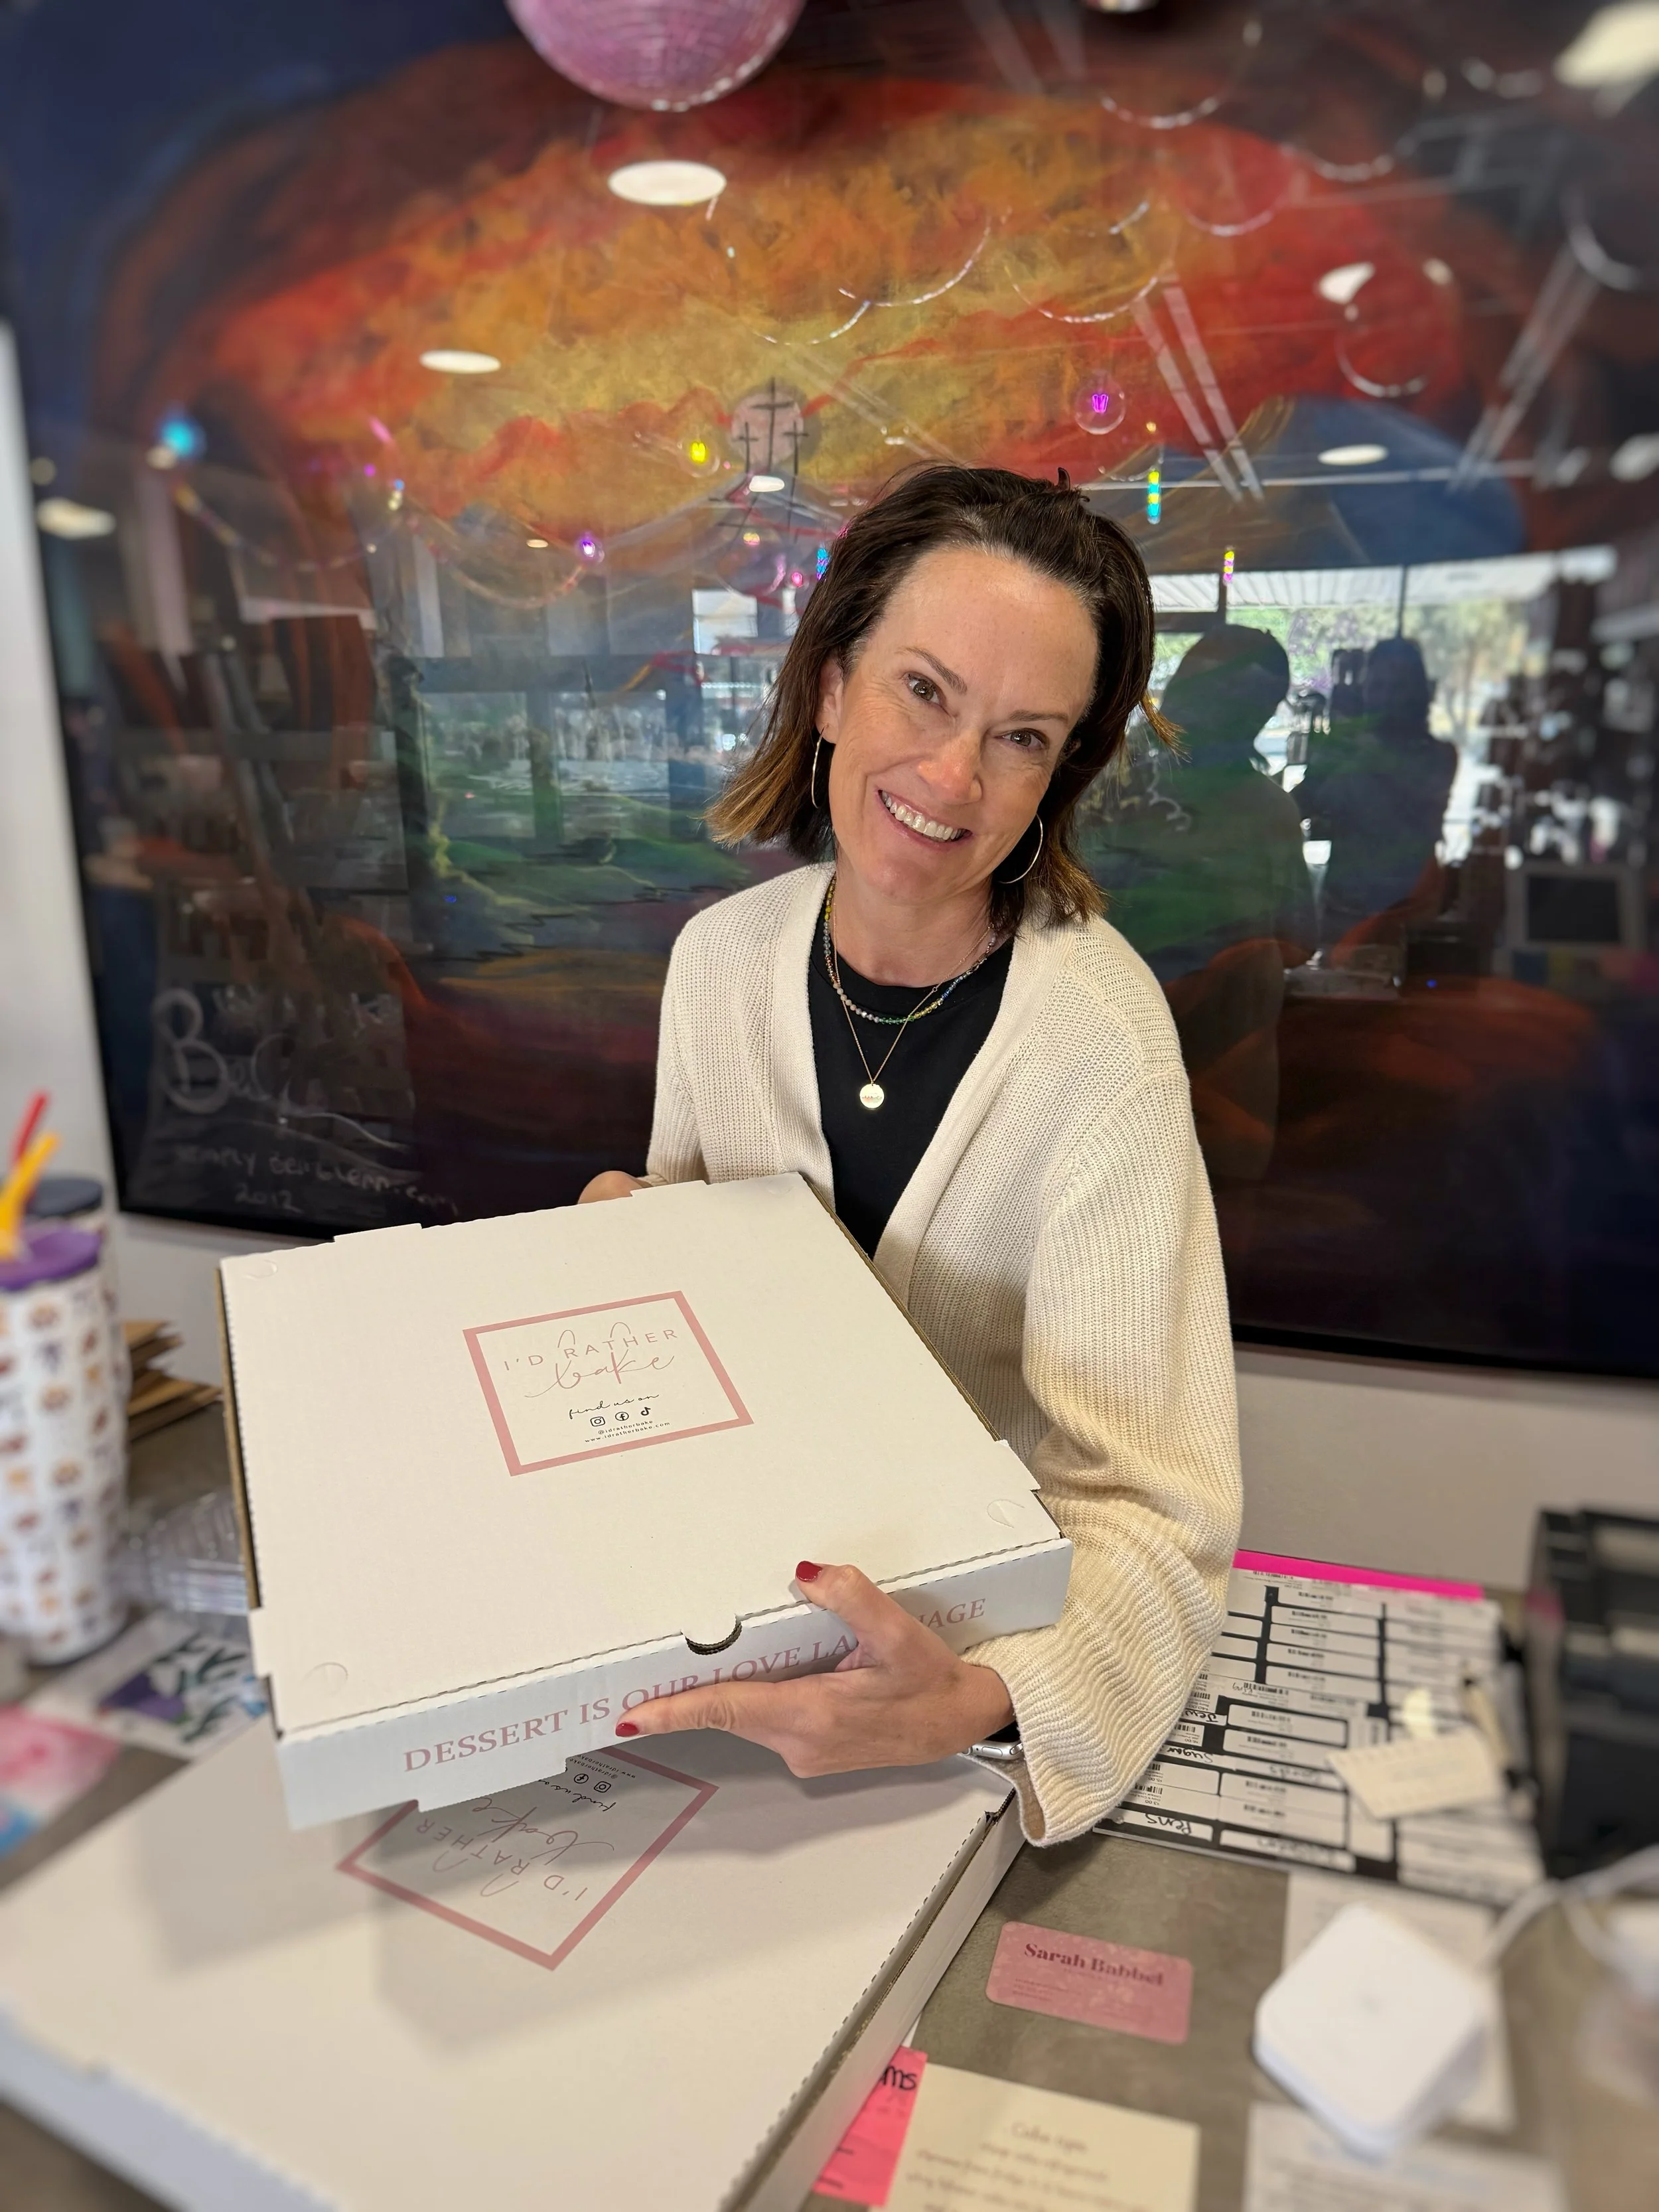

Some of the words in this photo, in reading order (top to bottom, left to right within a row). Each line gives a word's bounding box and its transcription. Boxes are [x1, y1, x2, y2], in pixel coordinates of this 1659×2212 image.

[504, 1354, 543, 1371] I'D
[563, 1329, 678, 1359] RATHER
[524, 1321, 675, 1398] bake
[569, 1400, 611, 1420] find
[585, 1422, 670, 1443] www.idratherbake.com
[598, 1420, 654, 1435] @idratherbake
[403, 1709, 568, 1772] DESSERT
[579, 1697, 611, 1725] IS
[621, 1674, 699, 1710] OUR
[712, 1647, 800, 1685] LOVE
[812, 1597, 987, 1661] LAAGE
[1166, 1747, 1214, 1763] Sugar
[569, 1758, 618, 1779] @idratherbake
[571, 1793, 616, 1812] find
[1144, 1812, 1193, 1836] Pens
[415, 1817, 530, 1877] RATHER
[543, 1874, 589, 1901] I'D
[1024, 1943, 1086, 1969] Sarah
[1090, 1957, 1164, 1986] Babbel
